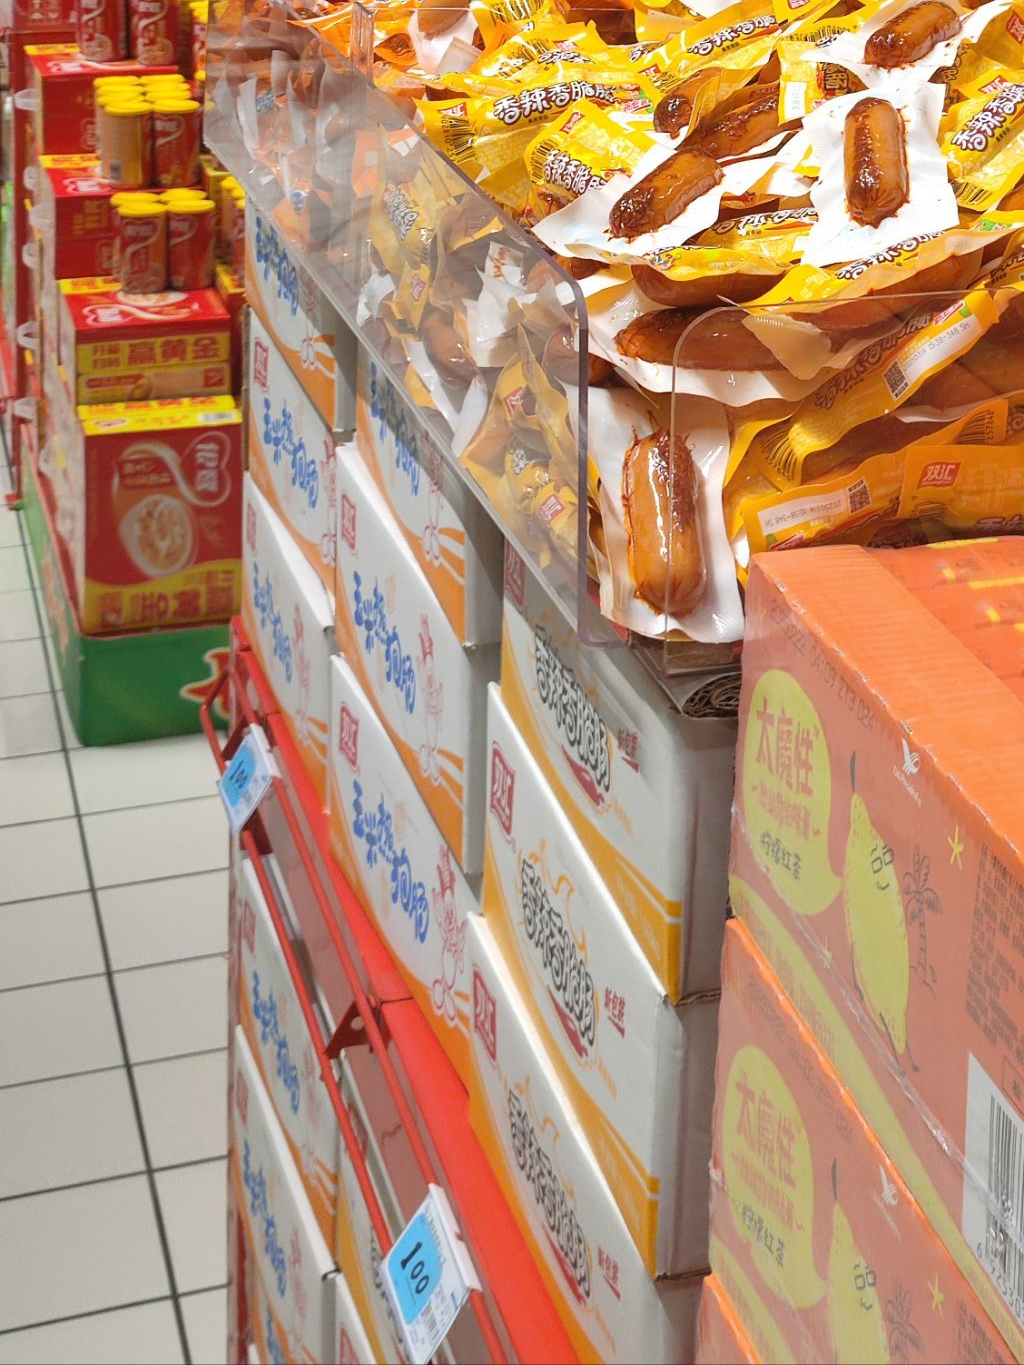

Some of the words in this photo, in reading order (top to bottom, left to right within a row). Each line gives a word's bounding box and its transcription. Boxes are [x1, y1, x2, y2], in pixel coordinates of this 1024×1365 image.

[917, 462, 961, 489] 双汇
[755, 697, 814, 797] 太魔性
[735, 1070, 797, 1191] 太魔性
